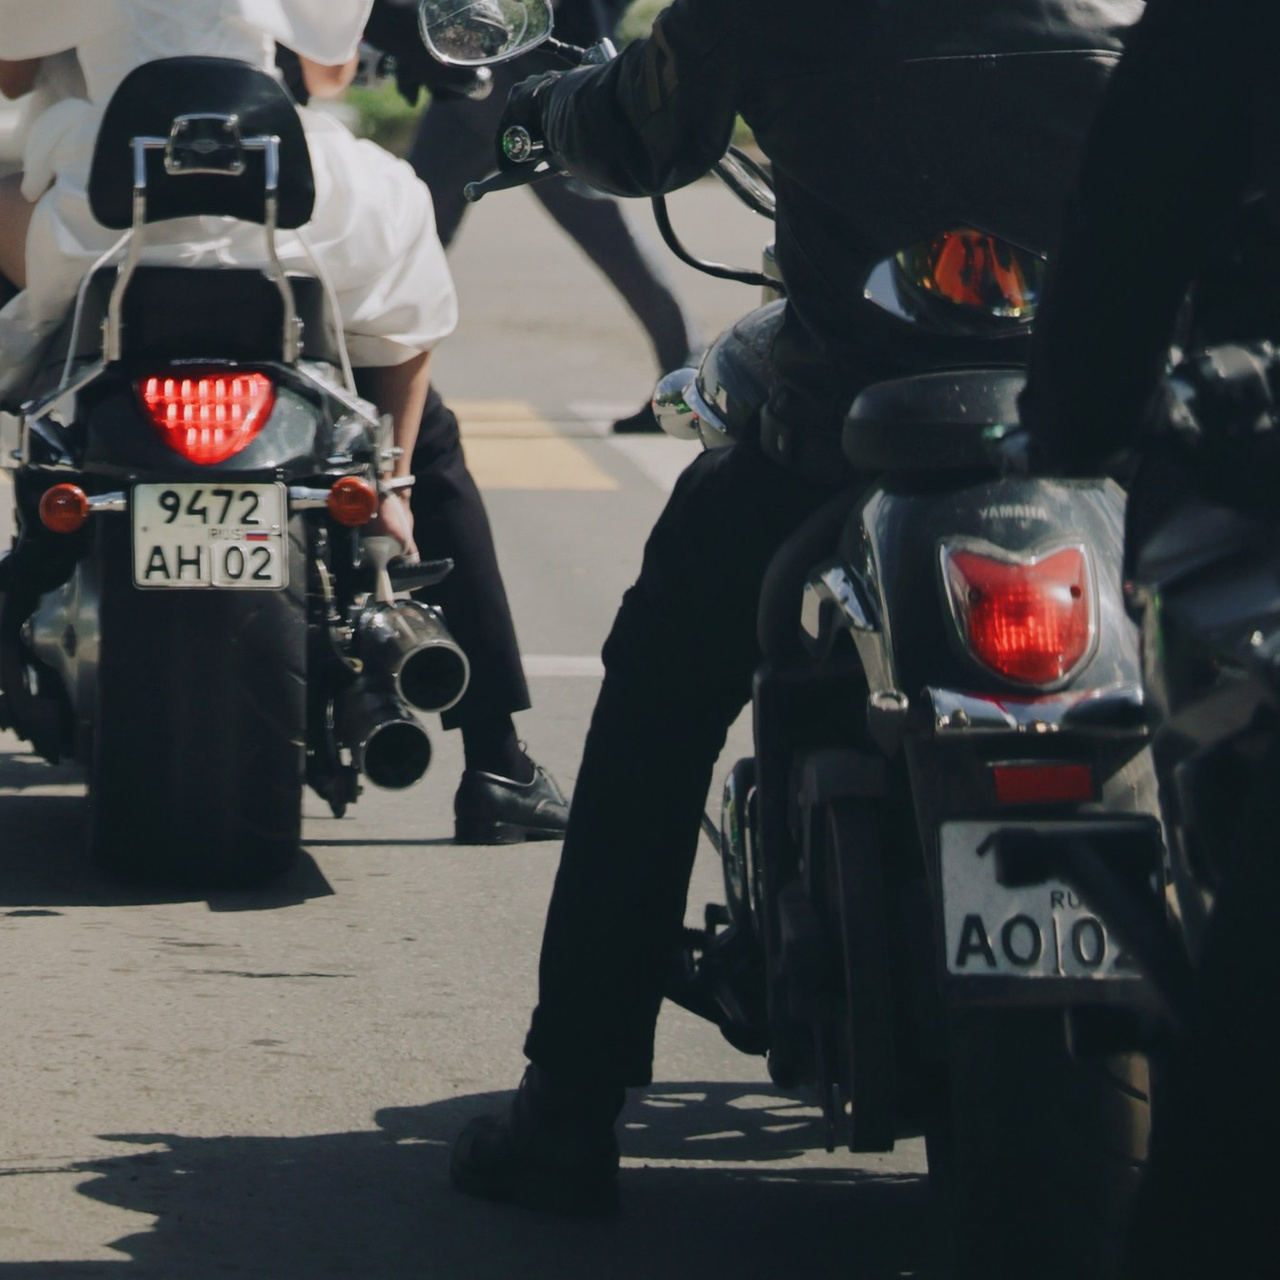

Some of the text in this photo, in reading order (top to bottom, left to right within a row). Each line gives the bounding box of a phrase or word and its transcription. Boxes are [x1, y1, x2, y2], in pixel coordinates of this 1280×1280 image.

[158, 490, 260, 525] 9472
[979, 505, 1047, 521] YAMAHA
[209, 528, 243, 540] RUS
[224, 545, 273, 581] 02
[1050, 891, 1082, 910] RU
